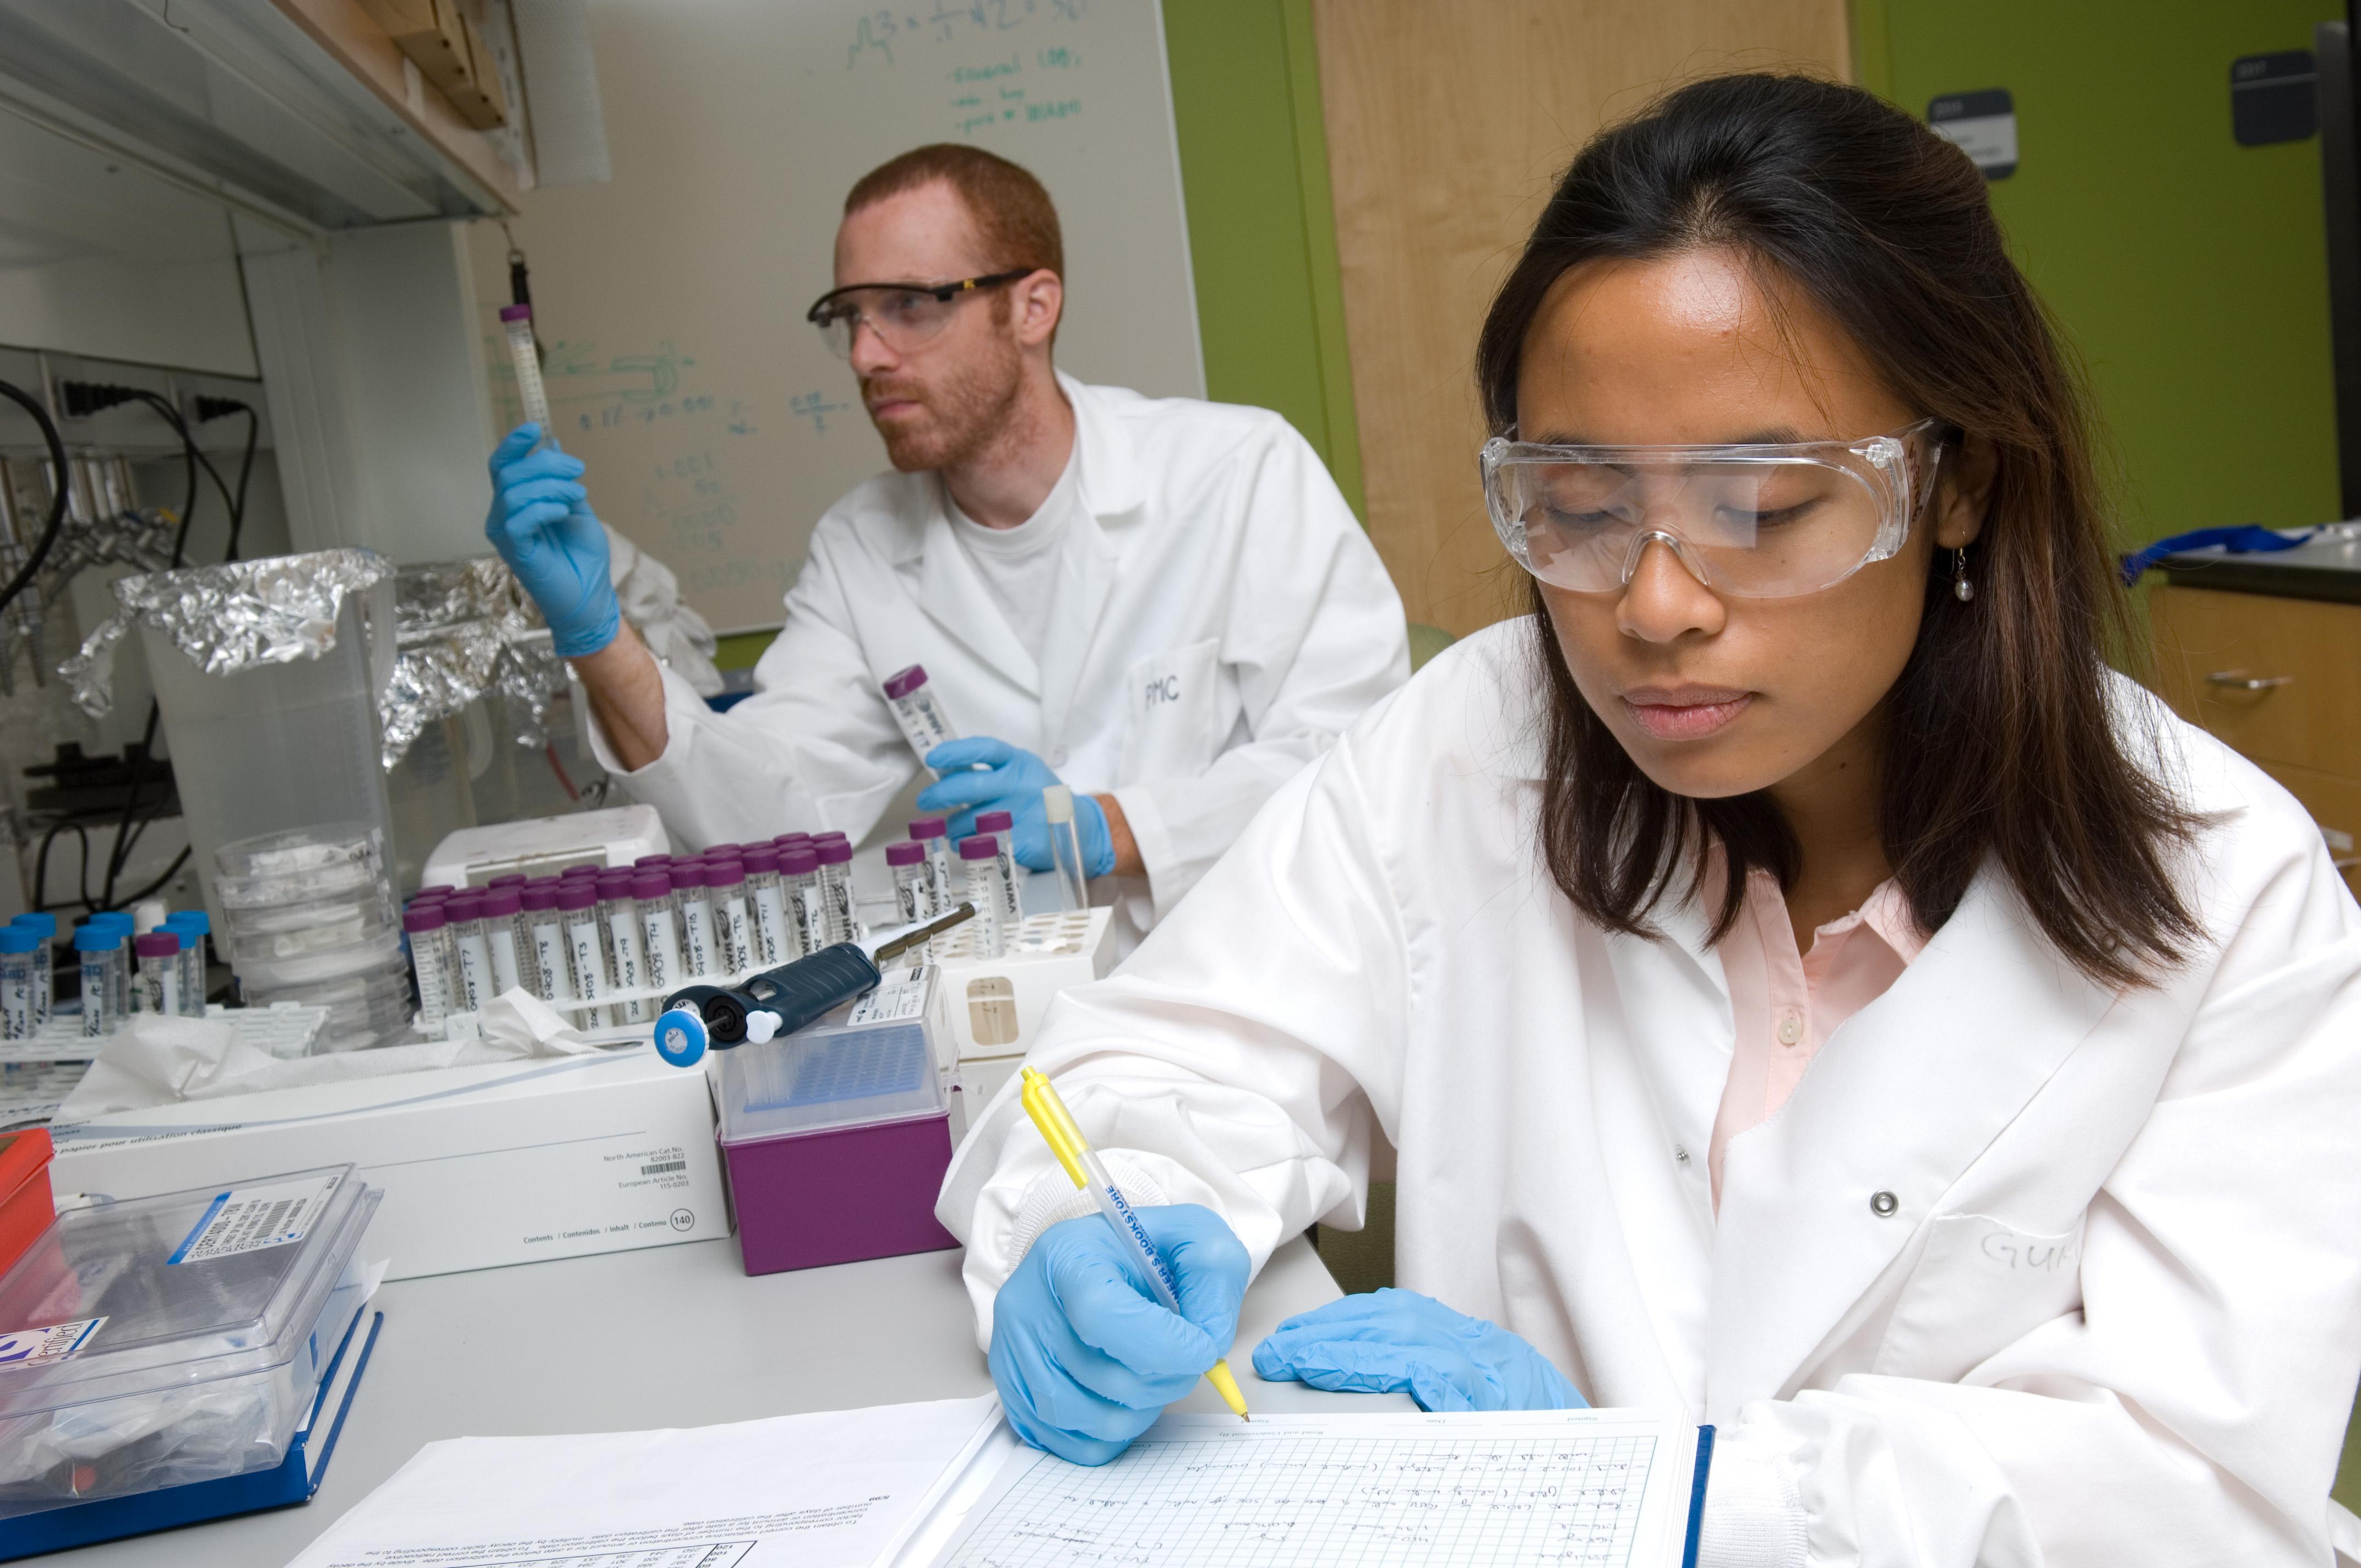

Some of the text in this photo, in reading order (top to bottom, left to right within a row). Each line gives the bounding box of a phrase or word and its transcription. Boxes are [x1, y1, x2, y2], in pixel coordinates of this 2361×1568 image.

[1005, 882, 1016, 913] VWR
[842, 918, 852, 942] WR
[724, 943, 735, 975] VWR
[52, 1137, 70, 1146] her
[60, 1125, 242, 1156] papier pour utilisation classique
[604, 1146, 684, 1162] North American Cat.No.
[650, 1152, 685, 1163] 82003-822
[618, 1179, 651, 1189] European
[652, 1175, 674, 1184] Article
[660, 1180, 689, 1190] 115-0203
[1106, 1185, 1154, 1256] BOOKSTORE
[523, 1215, 691, 1244] Contents Contenidos Inhalt Contenu 140
[28, 1323, 84, 1366] Certified
[804, 1508, 868, 1519] concentration
[765, 1518, 833, 1528] corresponding
[639, 1536, 703, 1544] concentration
